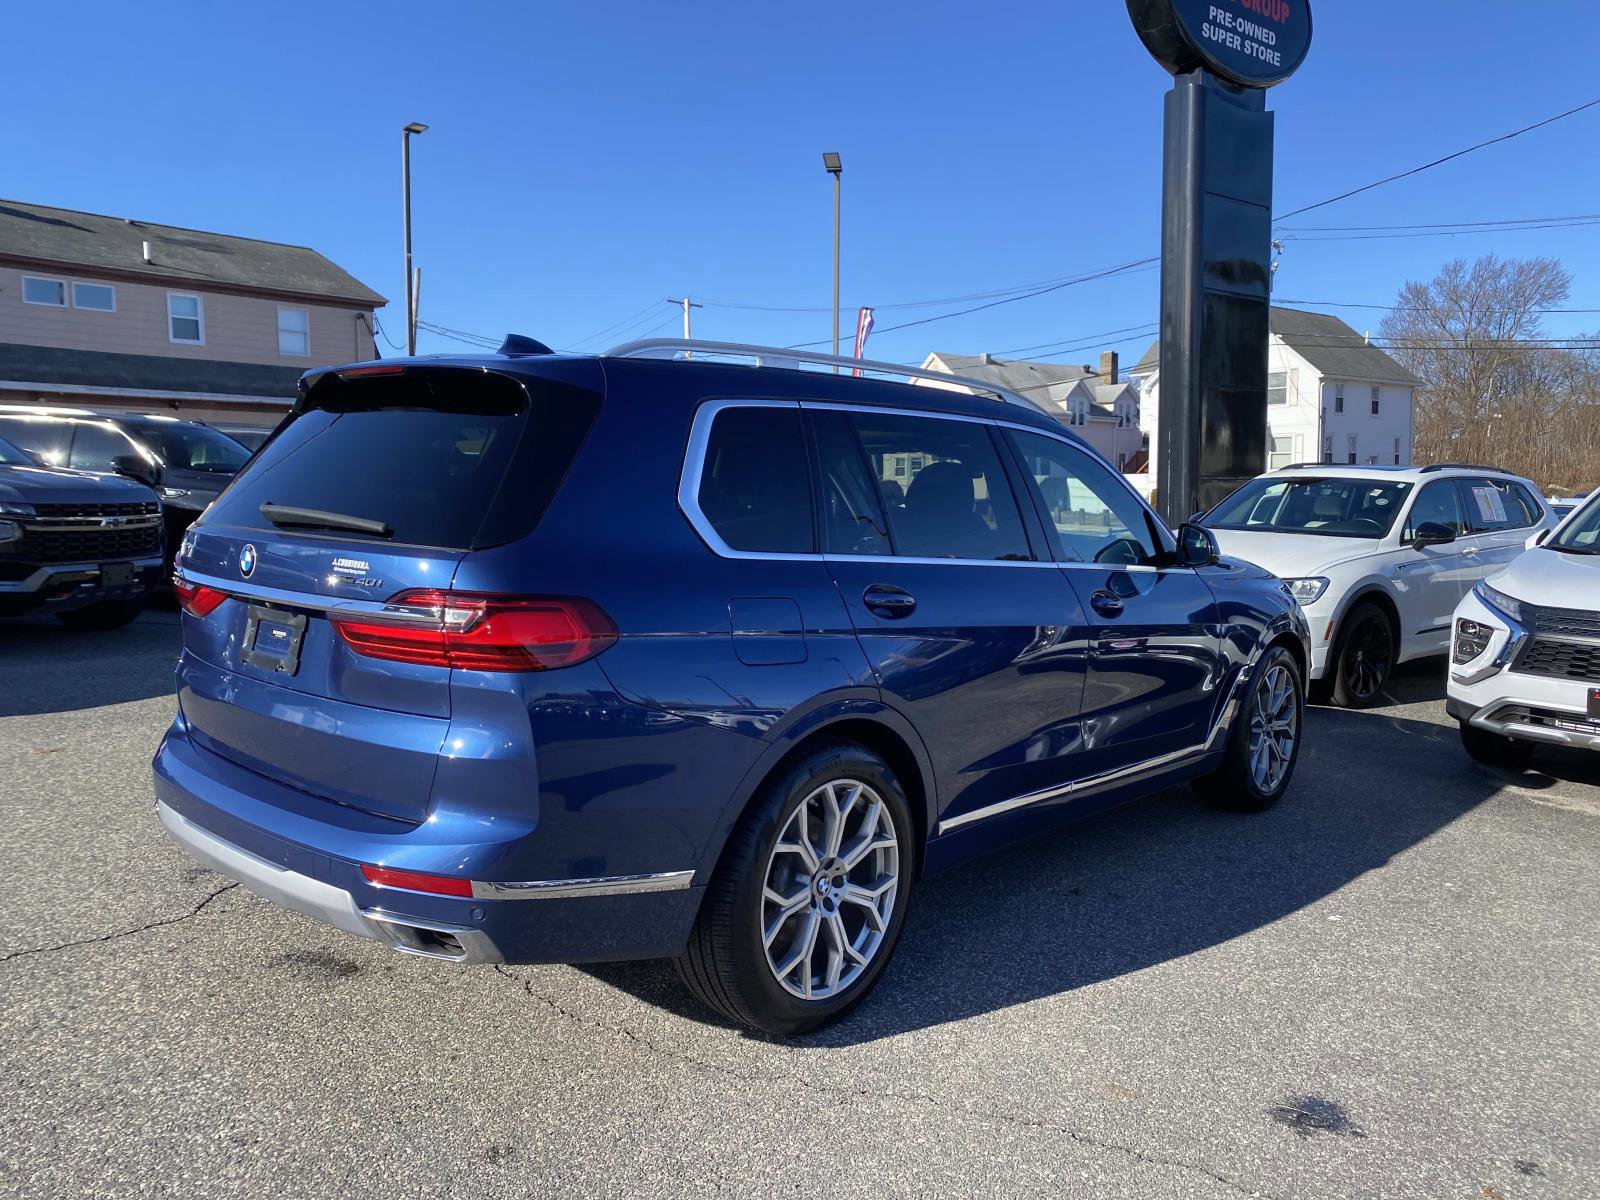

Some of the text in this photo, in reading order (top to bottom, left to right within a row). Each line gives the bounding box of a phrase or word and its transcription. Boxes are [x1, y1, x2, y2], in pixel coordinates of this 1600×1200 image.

[1201, 22, 1281, 67] SUPER STORE
[1209, 5, 1276, 46] PRE-OWNED
